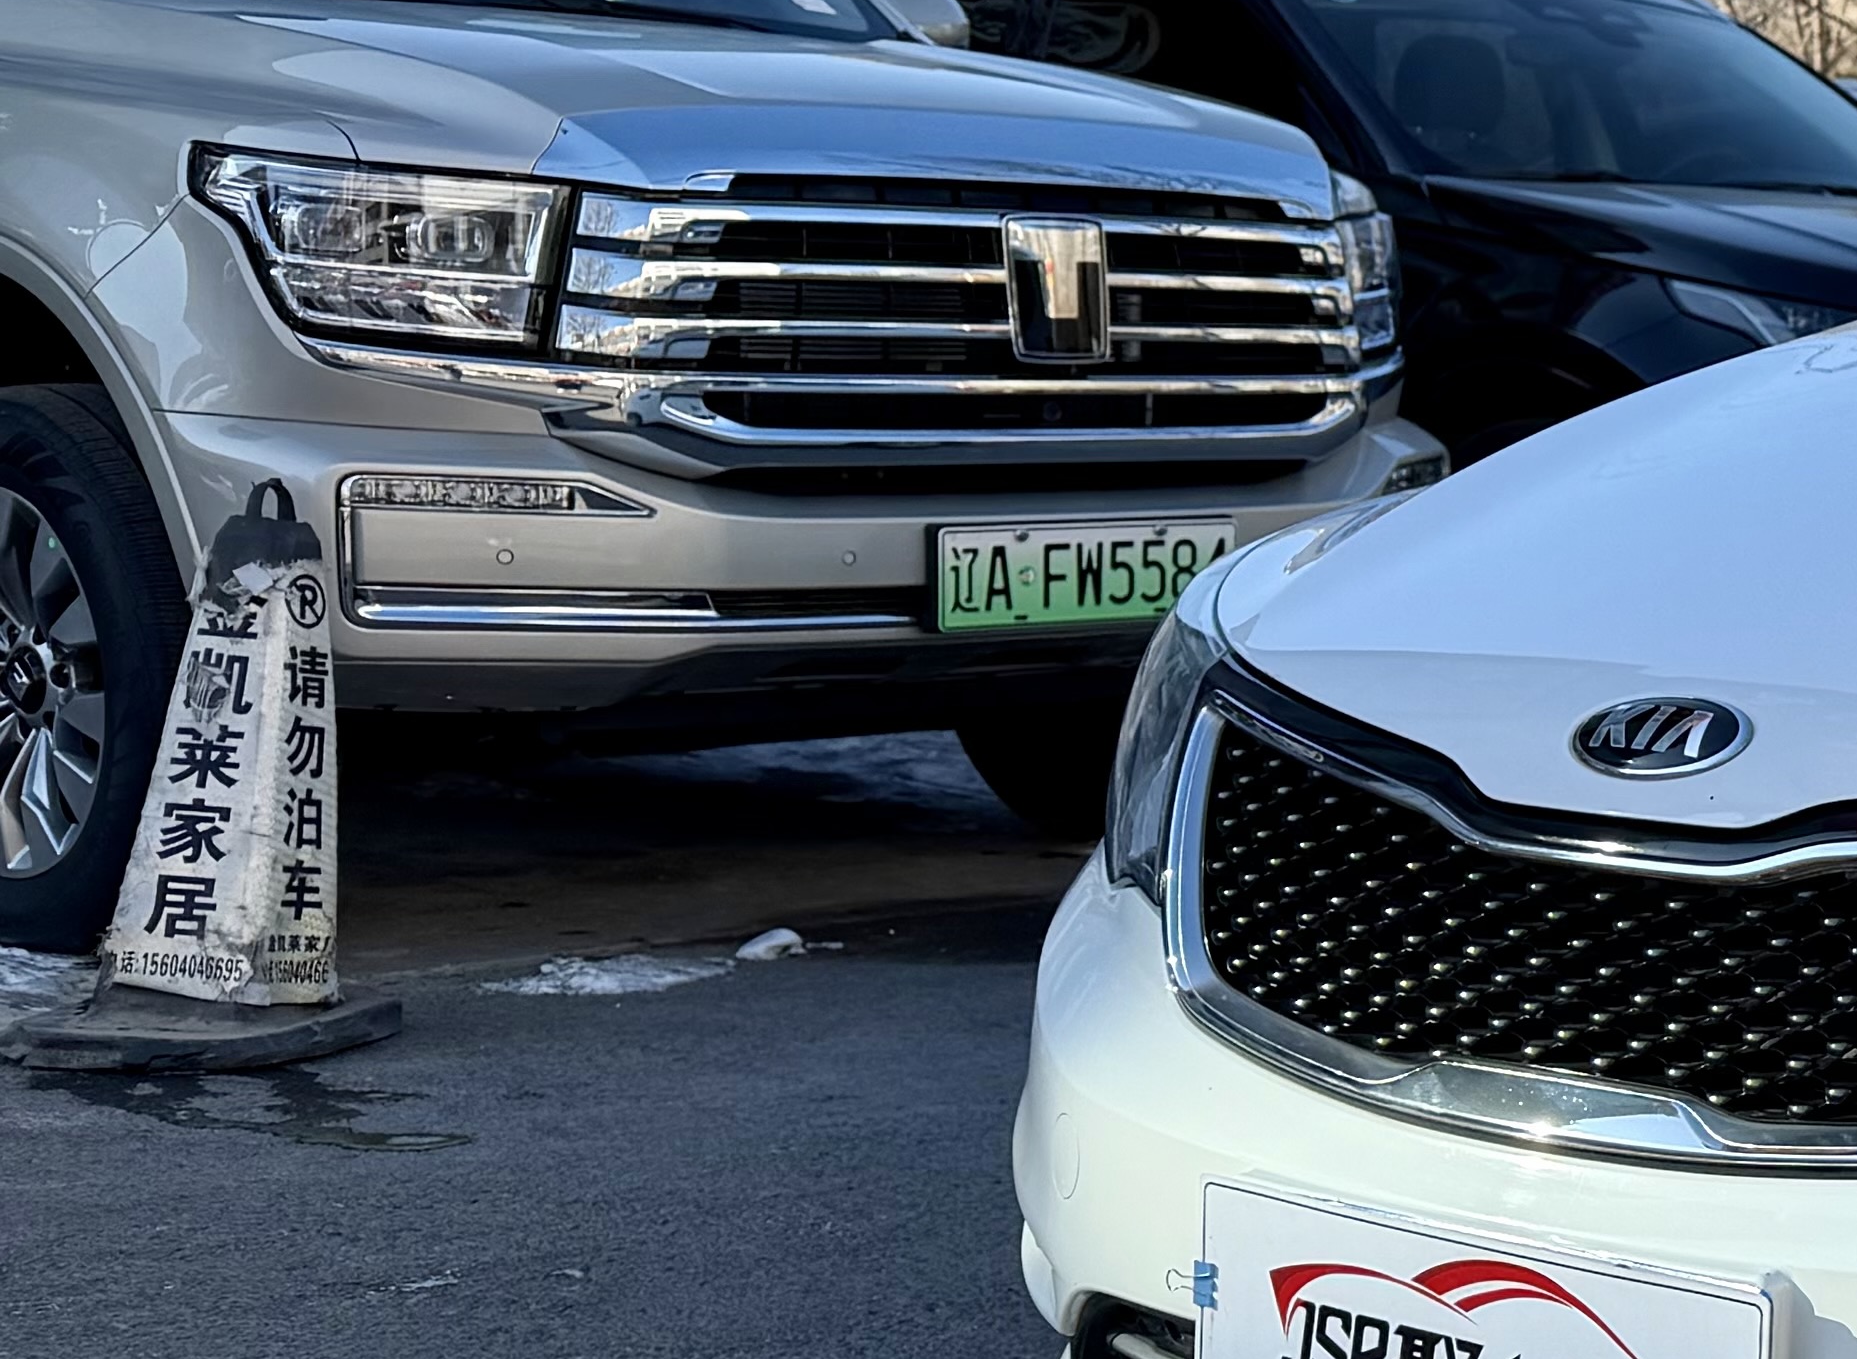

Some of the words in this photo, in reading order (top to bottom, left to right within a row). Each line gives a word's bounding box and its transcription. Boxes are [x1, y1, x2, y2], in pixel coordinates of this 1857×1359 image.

[281, 645, 330, 921] 请勿泊车
[1588, 704, 1714, 759] KIA
